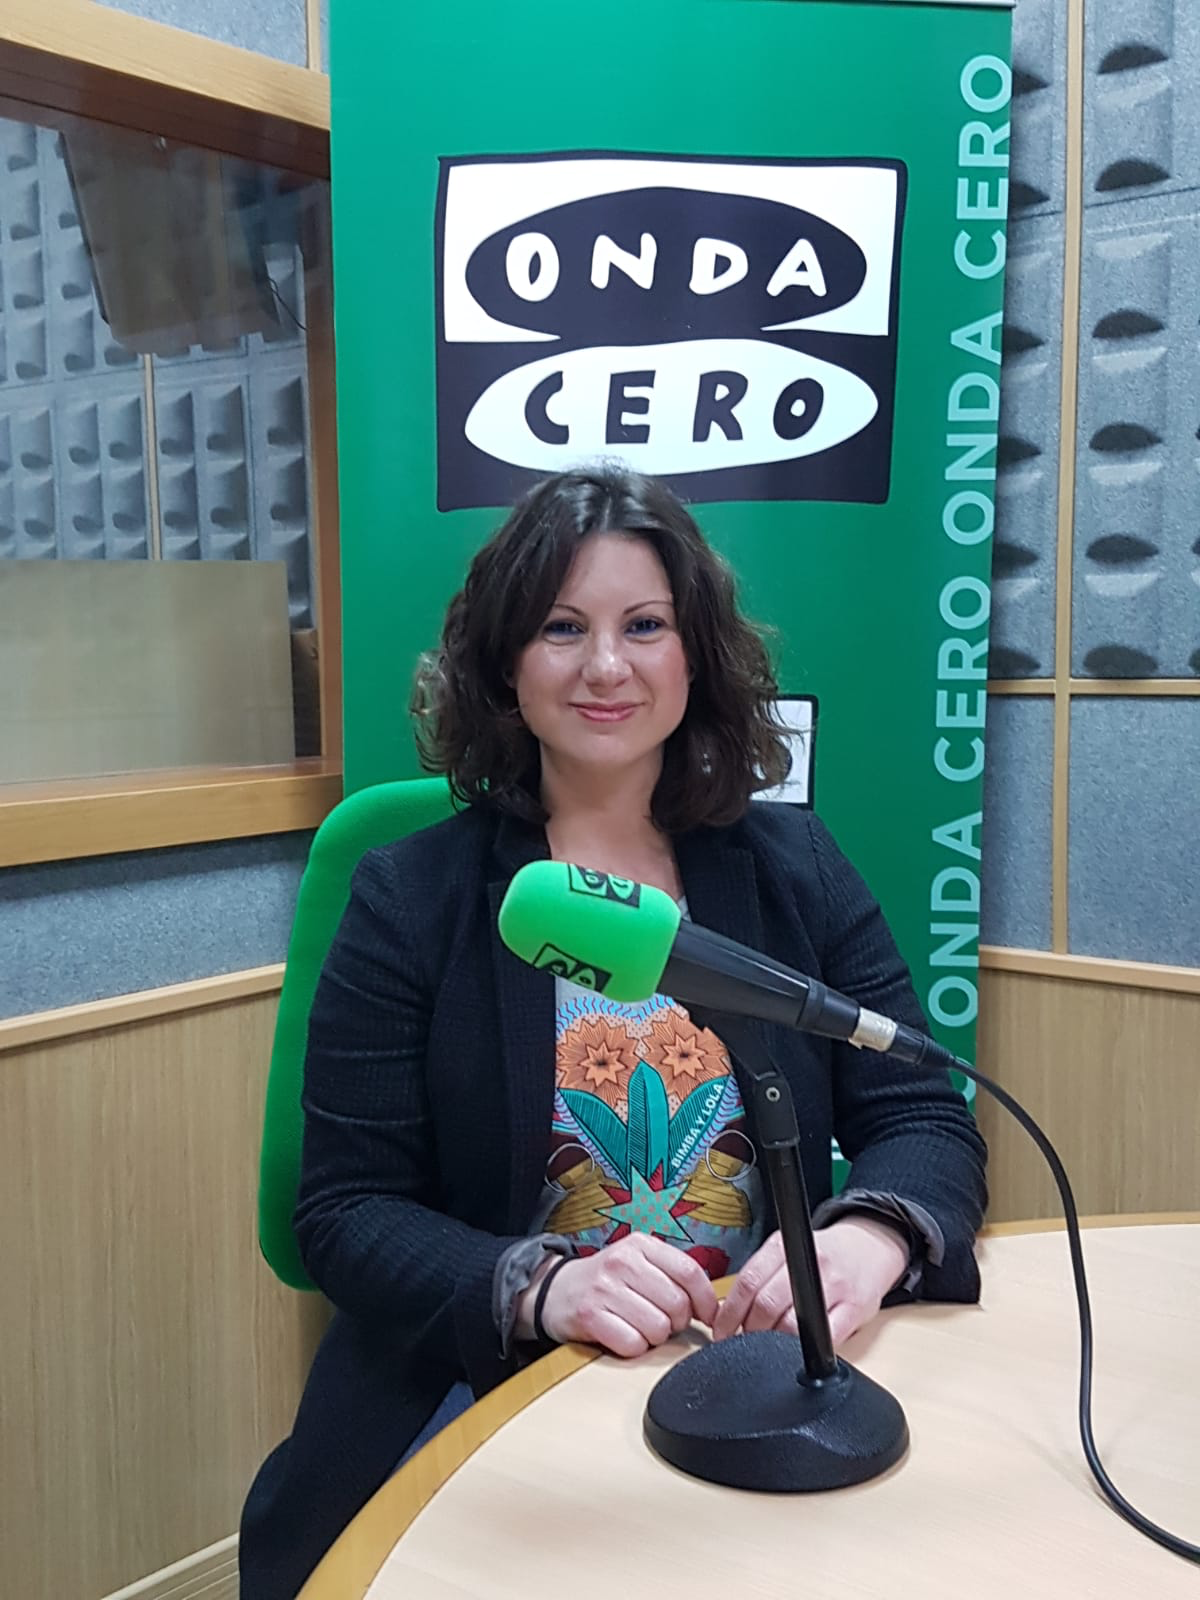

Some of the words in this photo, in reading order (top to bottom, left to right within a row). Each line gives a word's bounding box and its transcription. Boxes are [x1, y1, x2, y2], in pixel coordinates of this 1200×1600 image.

[506, 232, 827, 302] ONDA
[954, 54, 1012, 280] CERO
[524, 370, 824, 444] CERO
[942, 310, 1004, 545] ONDA
[934, 575, 991, 782] CERO
[928, 810, 983, 1027] ONDA
[671, 1127, 701, 1168] BIMBA
[695, 1115, 705, 1126] Y
[701, 1083, 725, 1117] LOLA
